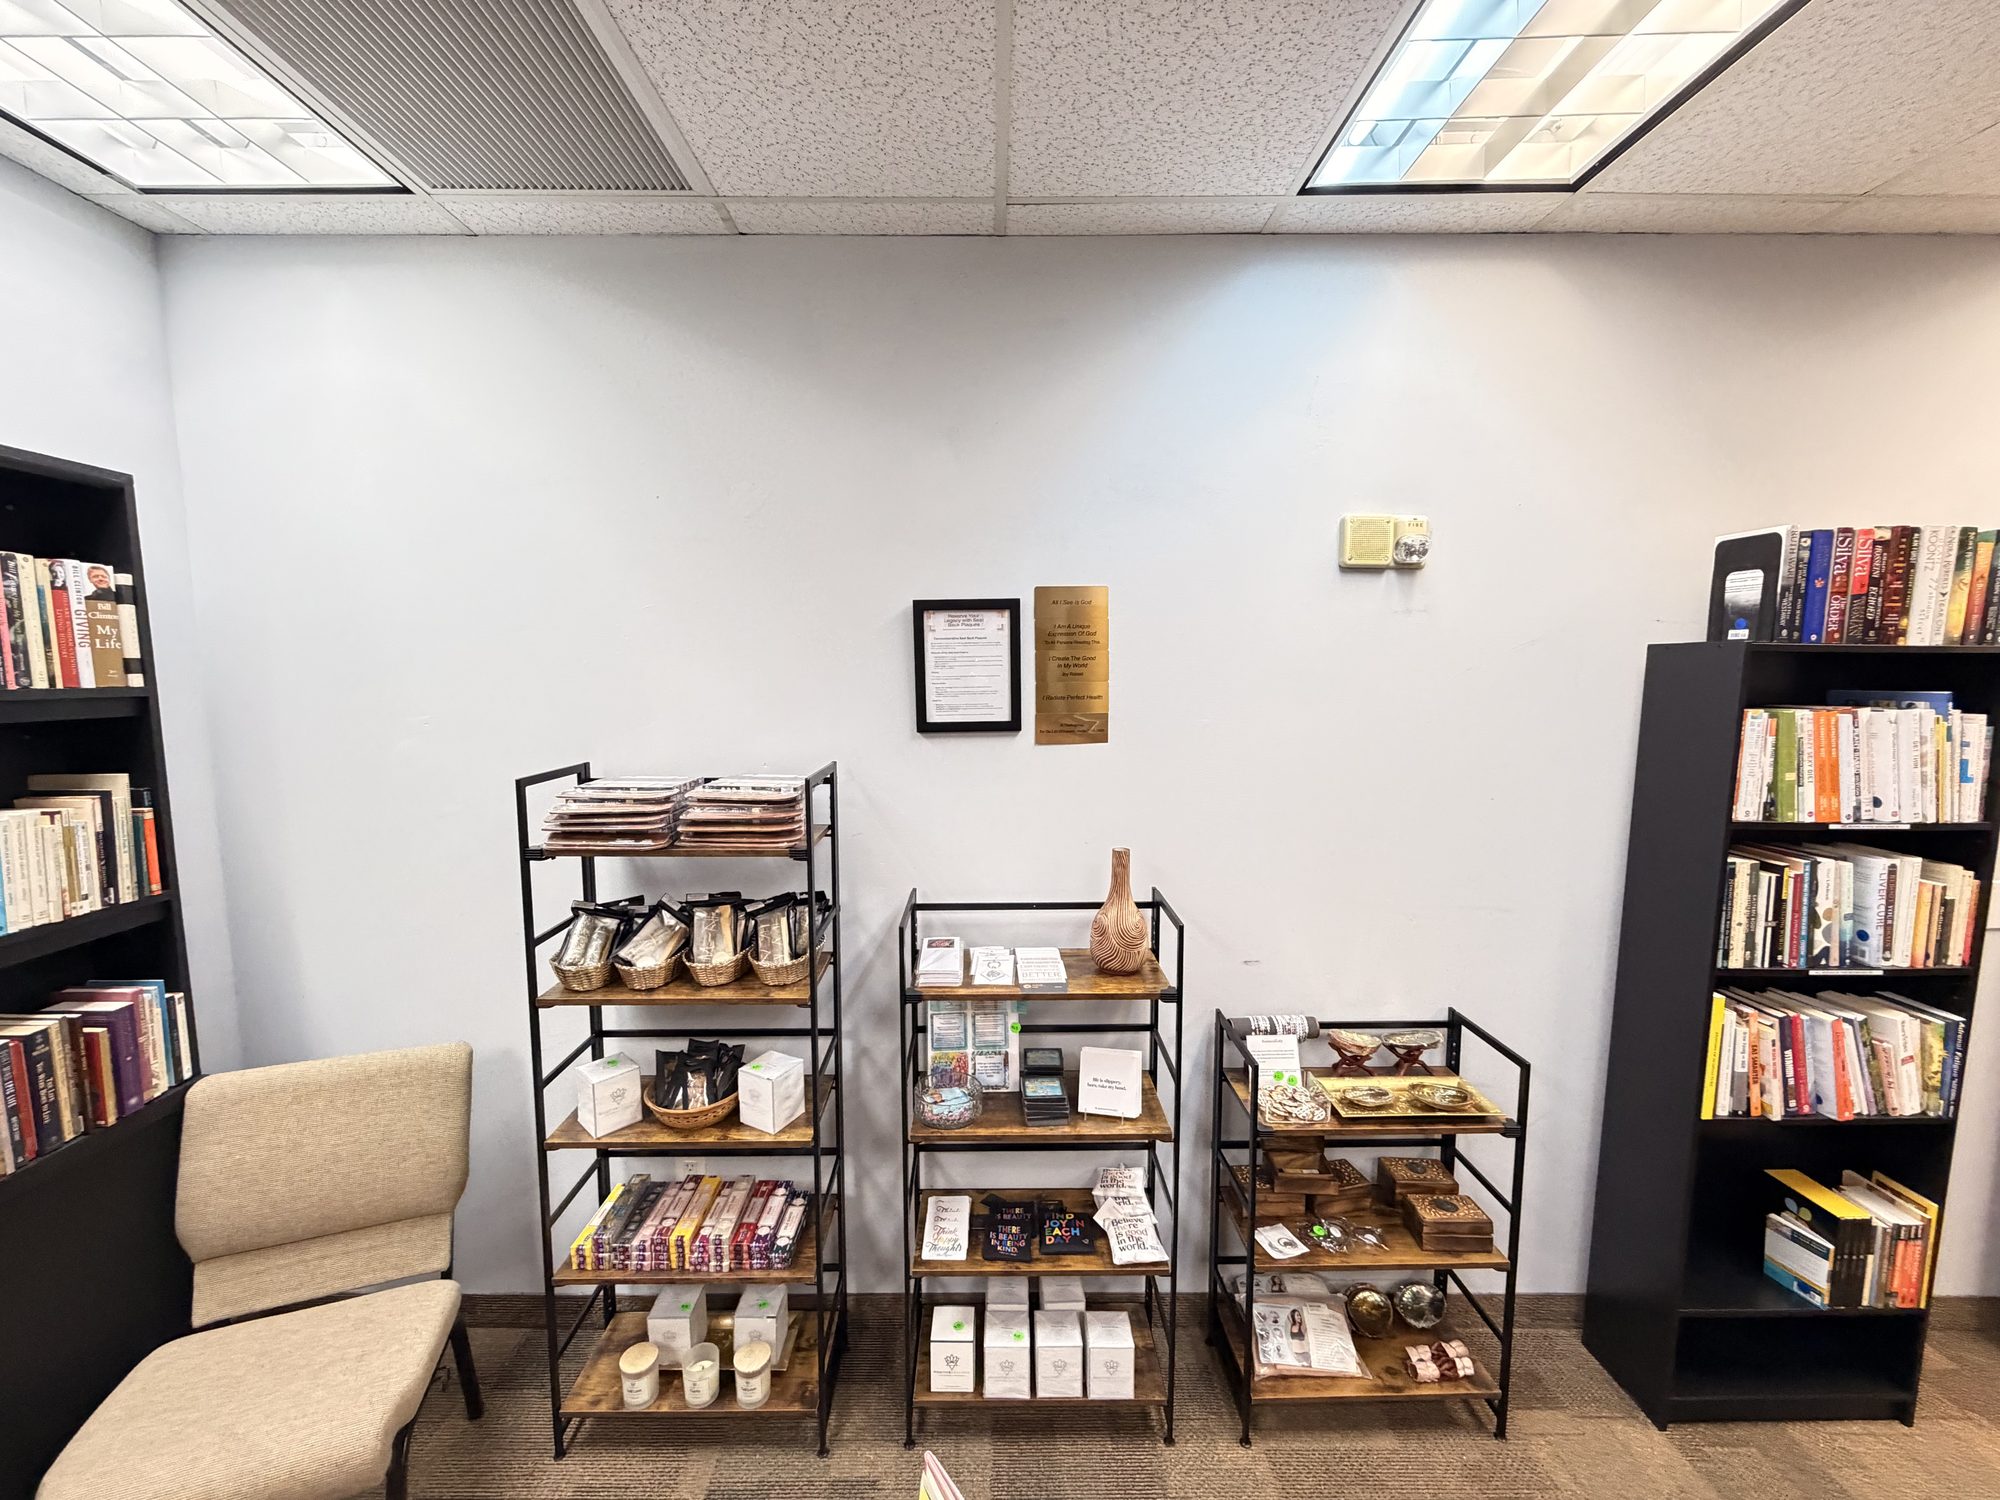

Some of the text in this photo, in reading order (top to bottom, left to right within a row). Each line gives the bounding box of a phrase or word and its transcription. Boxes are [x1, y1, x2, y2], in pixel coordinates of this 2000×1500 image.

[1834, 537, 1852, 575] Silva
[1924, 530, 1938, 571] KOONTZ
[1854, 539, 1873, 577] Silva
[1867, 586, 1878, 619] ECHOED
[1827, 595, 1840, 631] ORDER
[74, 609, 90, 648] GIVING
[97, 625, 118, 640] My
[95, 639, 122, 649] Life
[1936, 906, 1945, 940] Meditation
[1953, 1022, 1965, 1077] Adrenal Fatigue
[1112, 1217, 1144, 1227] Believe
[933, 1225, 958, 1235] Think
[998, 1225, 1021, 1234] THERE
[1045, 1228, 1080, 1236] EACH
[1125, 1228, 1148, 1237] good
[1046, 1236, 1072, 1244] DAY
[1119, 1242, 1148, 1251] world.
[926, 1242, 961, 1253] Thoughts
